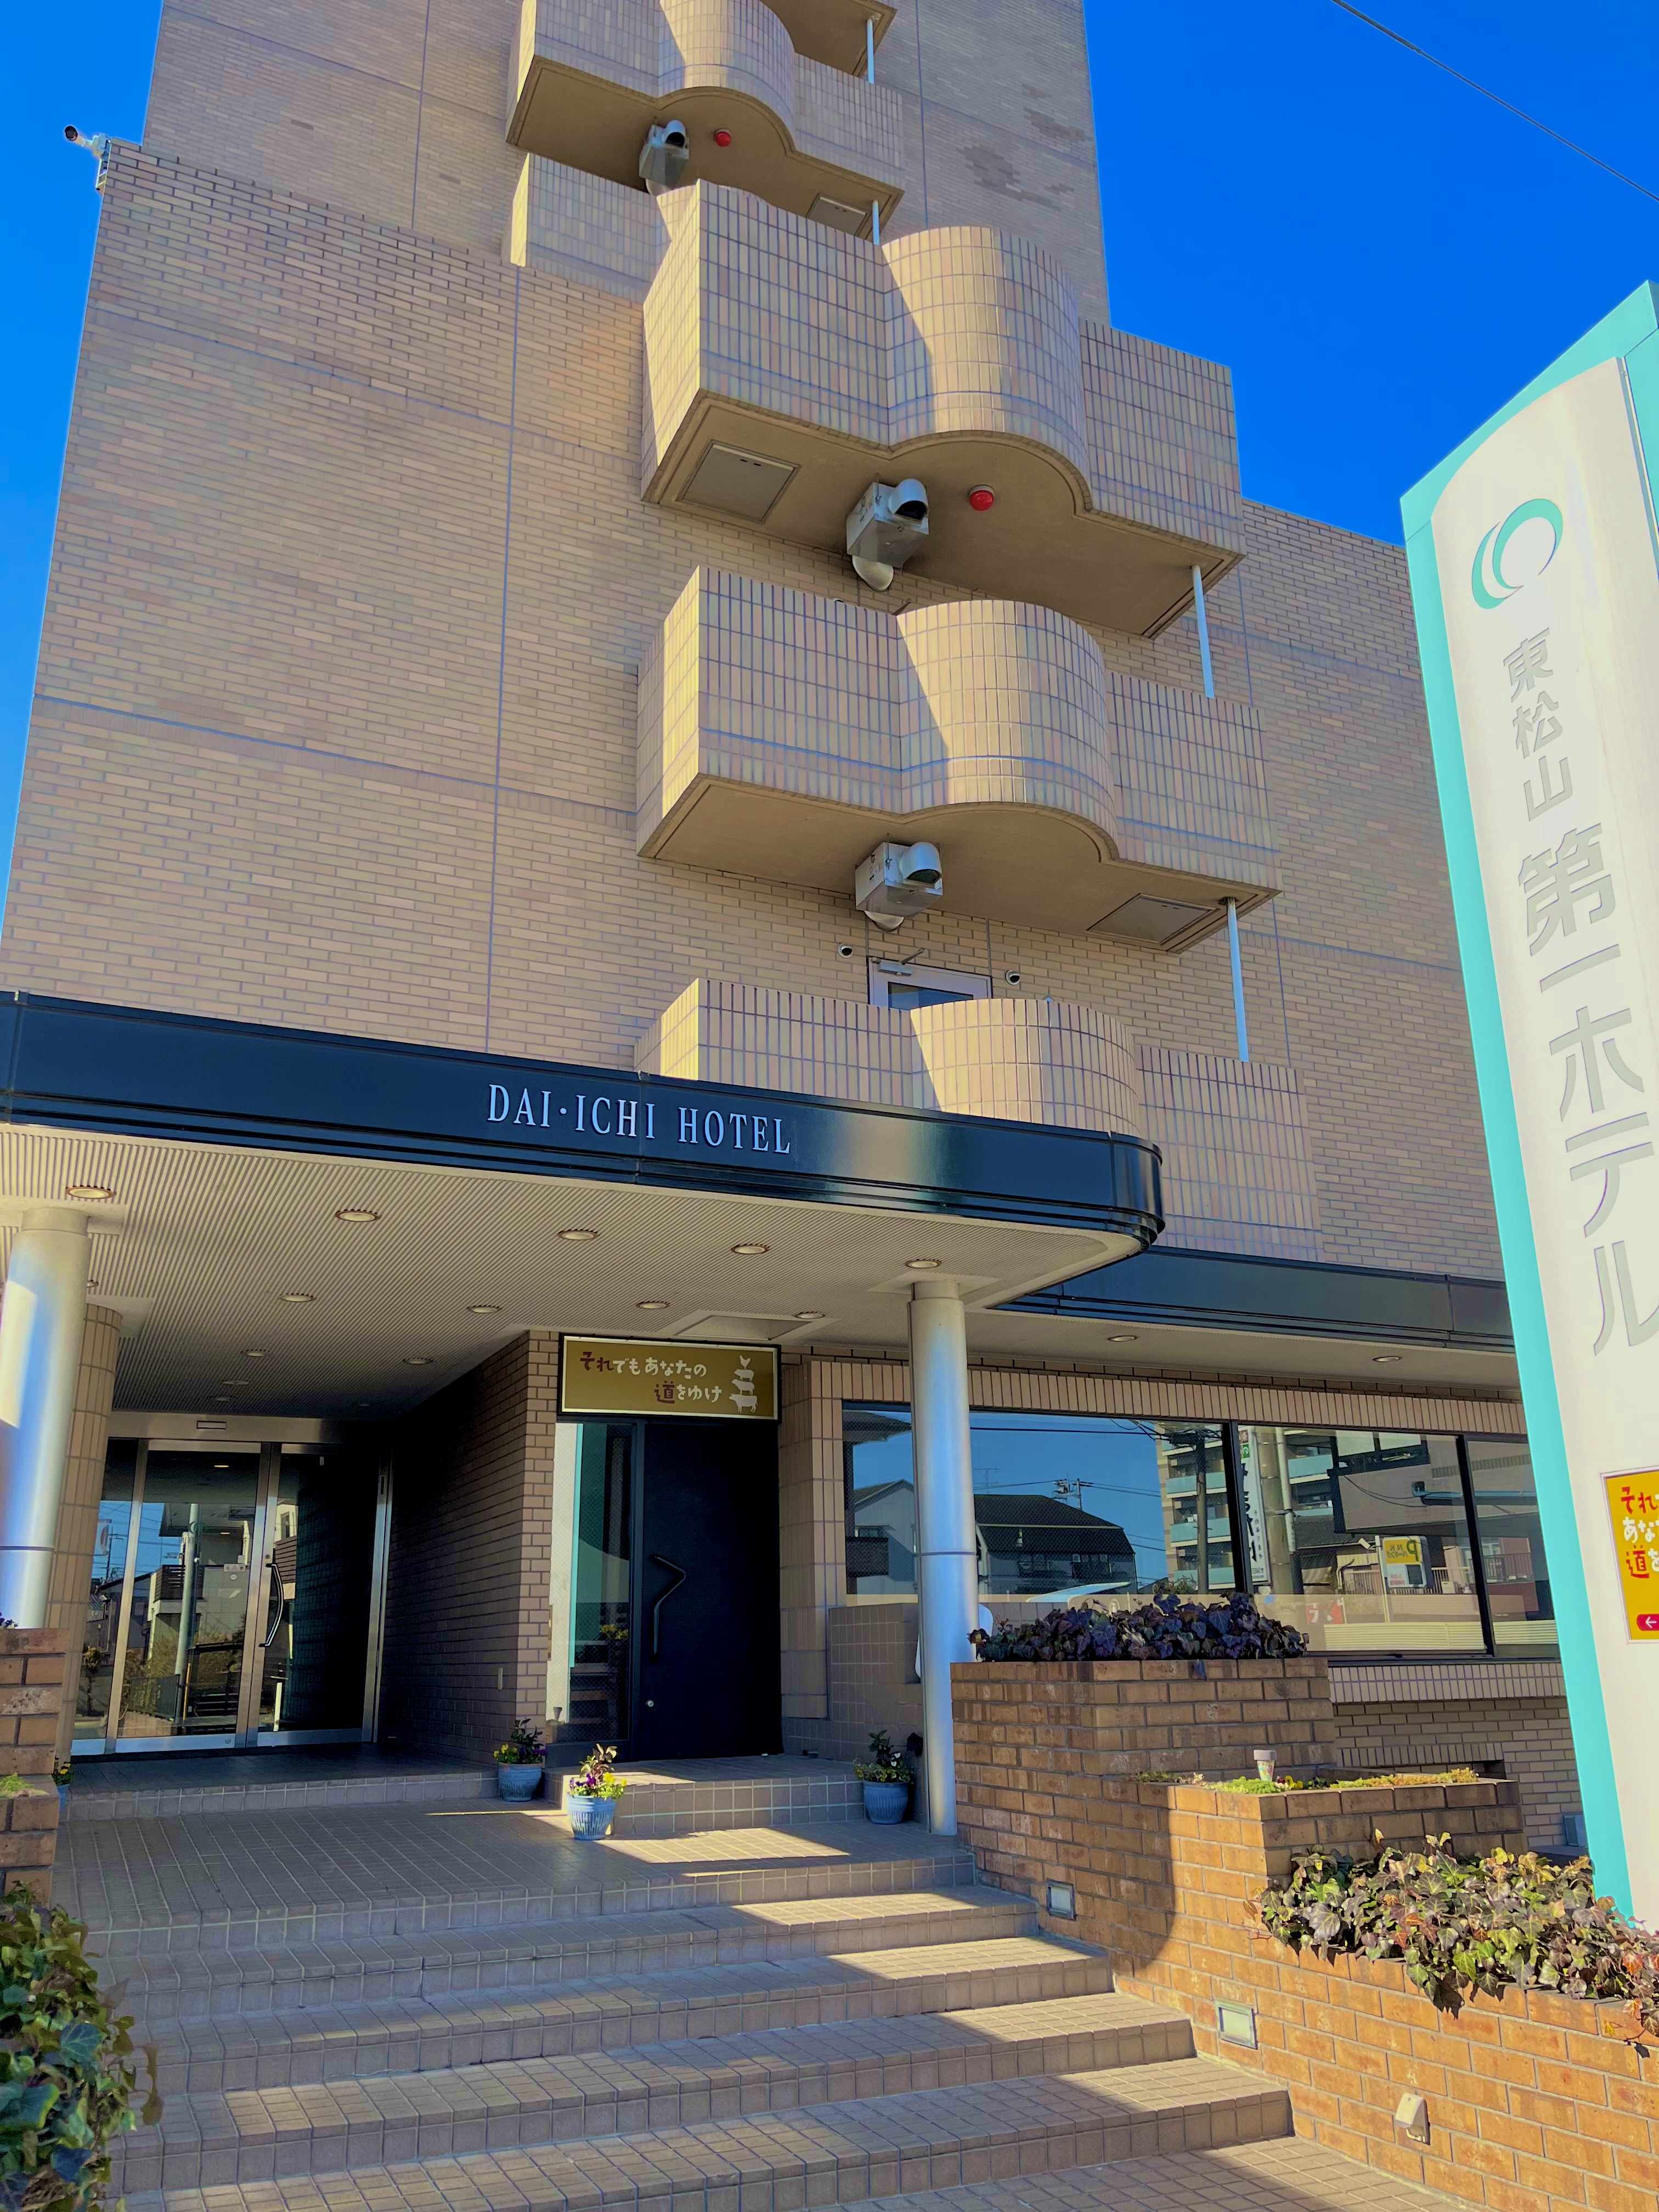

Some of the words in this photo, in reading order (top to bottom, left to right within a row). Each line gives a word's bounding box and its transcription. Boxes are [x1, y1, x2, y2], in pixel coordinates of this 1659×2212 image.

[1503, 627, 1659, 1357] 東松山第一ホテル
[678, 1106, 791, 1154] HOTEL
[579, 1351, 707, 1380] それでもあなたの
[654, 1380, 723, 1404] 道をゆけ
[1621, 1486, 1659, 1515] それ
[1622, 1516, 1659, 1544] あな
